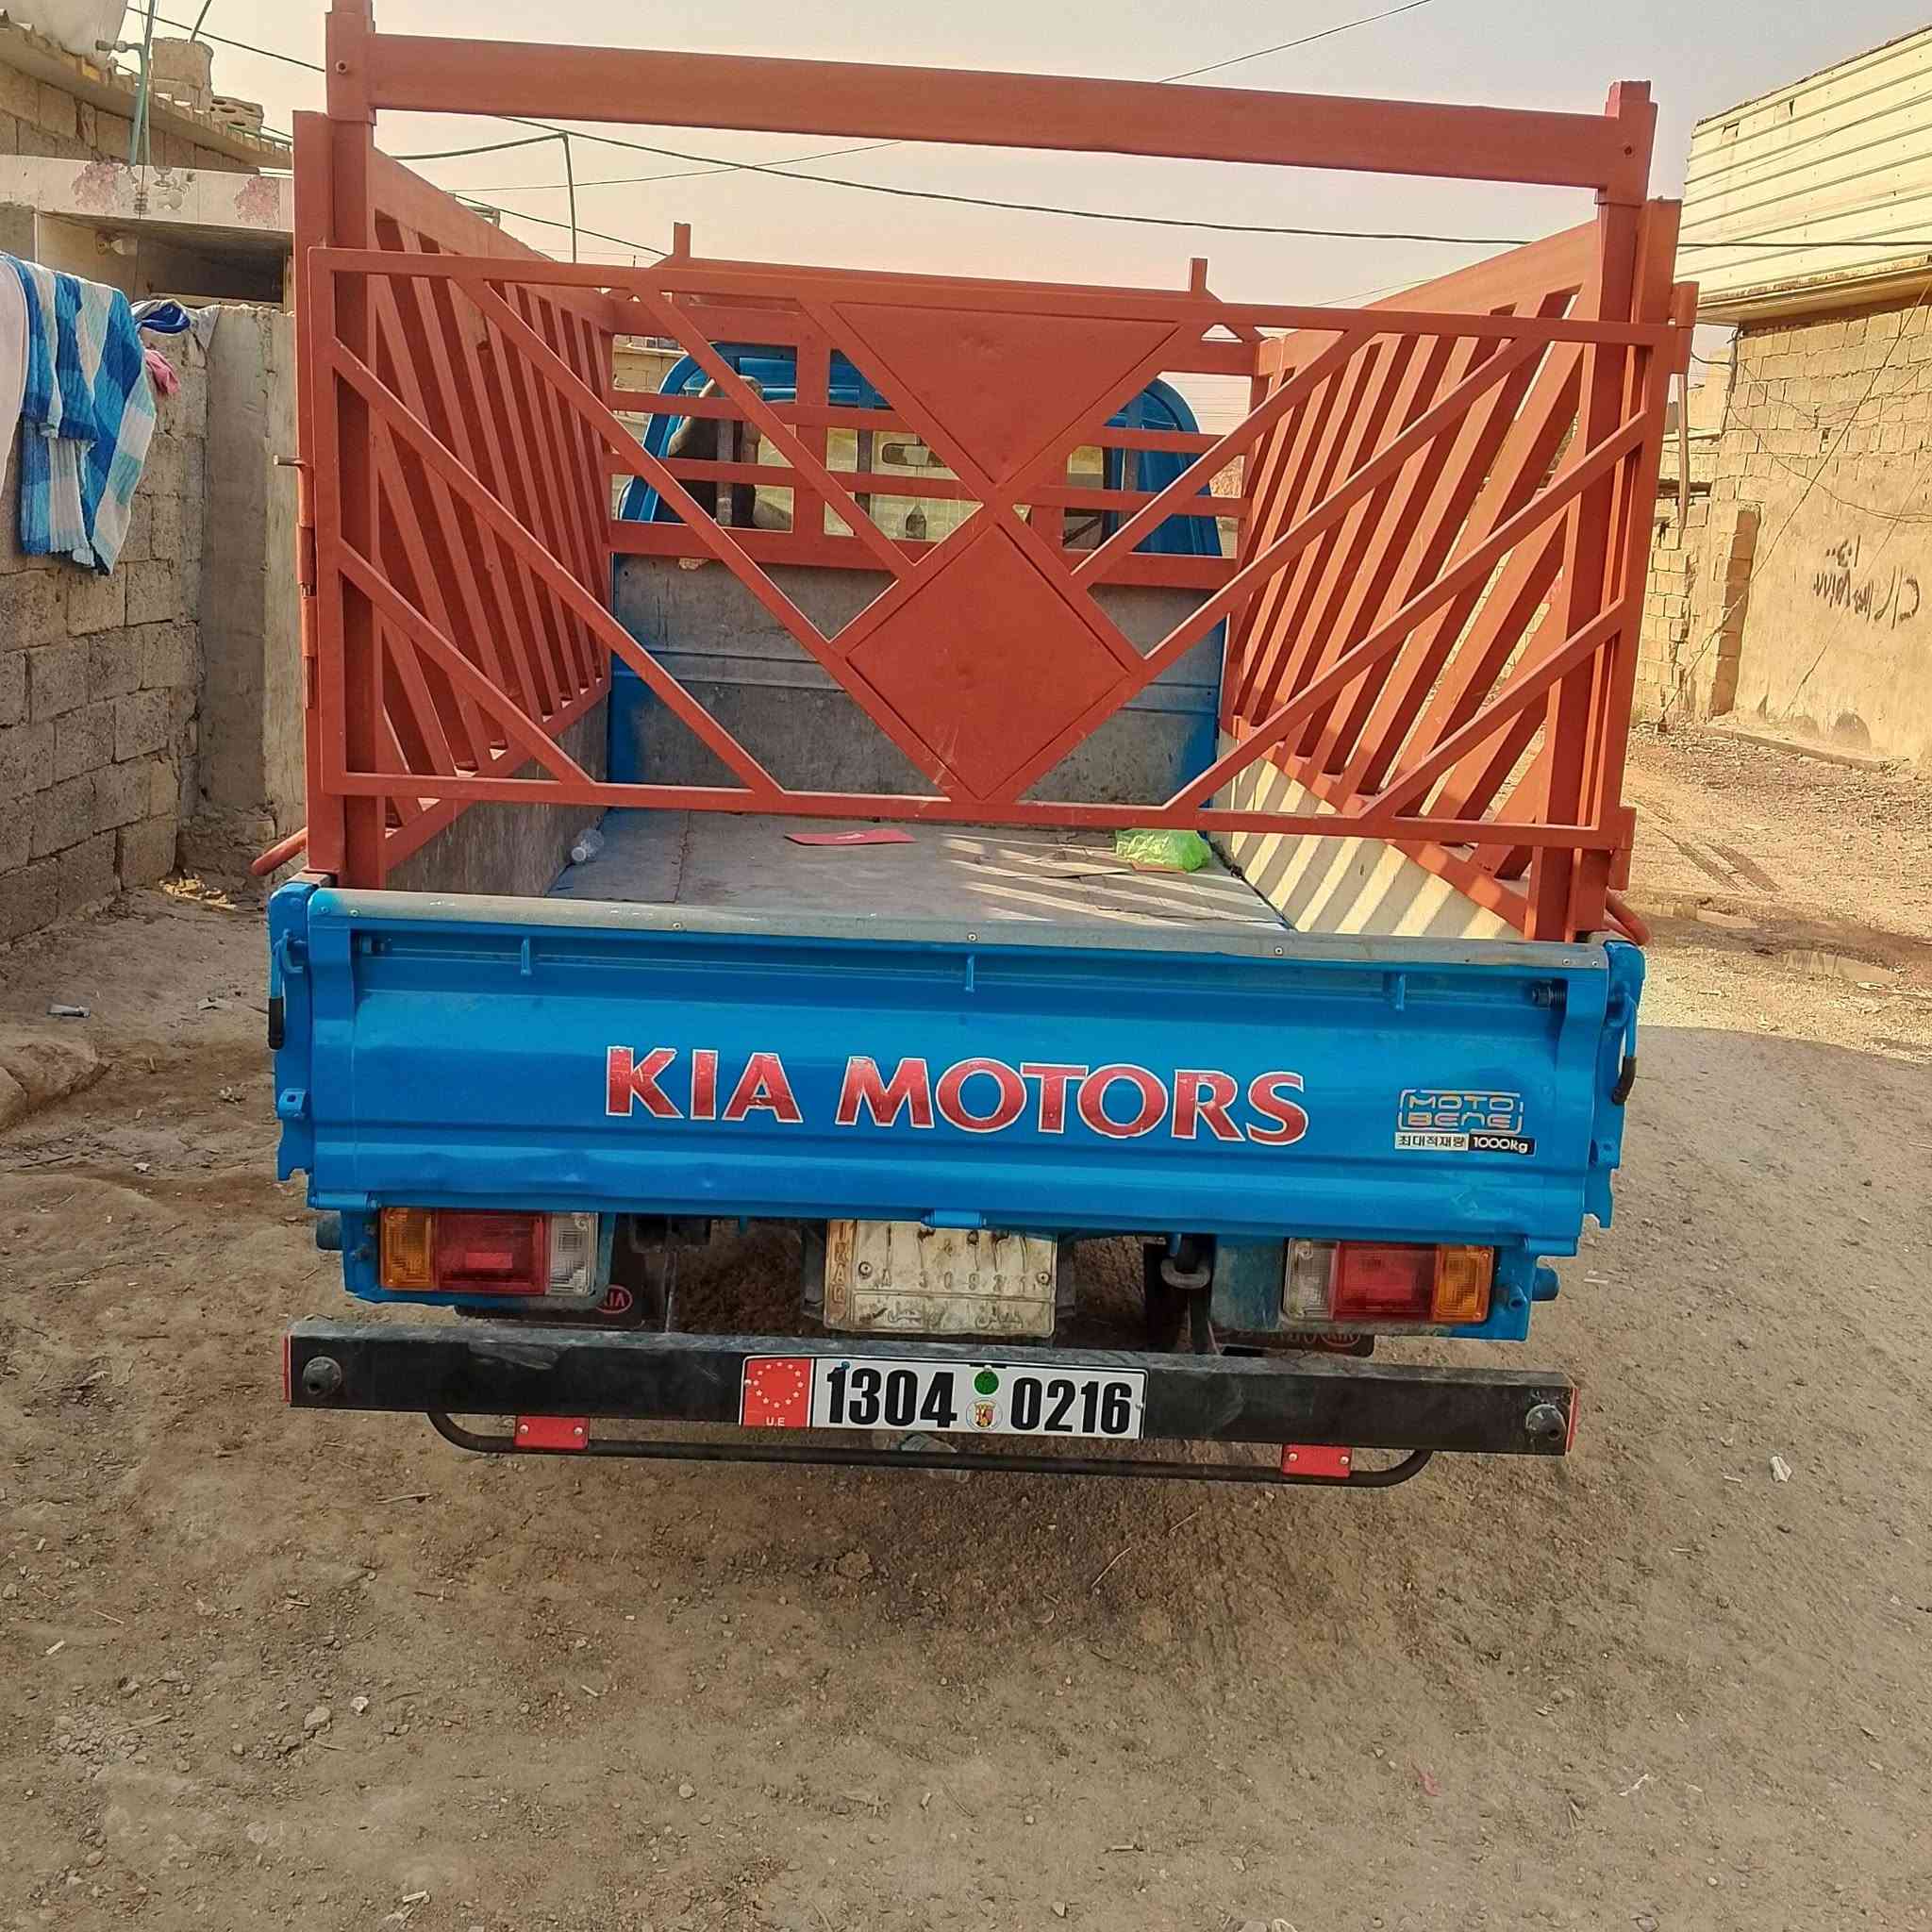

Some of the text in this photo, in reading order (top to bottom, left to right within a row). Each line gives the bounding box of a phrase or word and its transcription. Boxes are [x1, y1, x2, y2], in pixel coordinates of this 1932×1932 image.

[605, 1045, 1309, 1146] KIA MOTORS
[1408, 1095, 1515, 1112] MOTO
[1473, 1137, 1529, 1155] 1000kg
[825, 1366, 1133, 1435] 1304 0216
